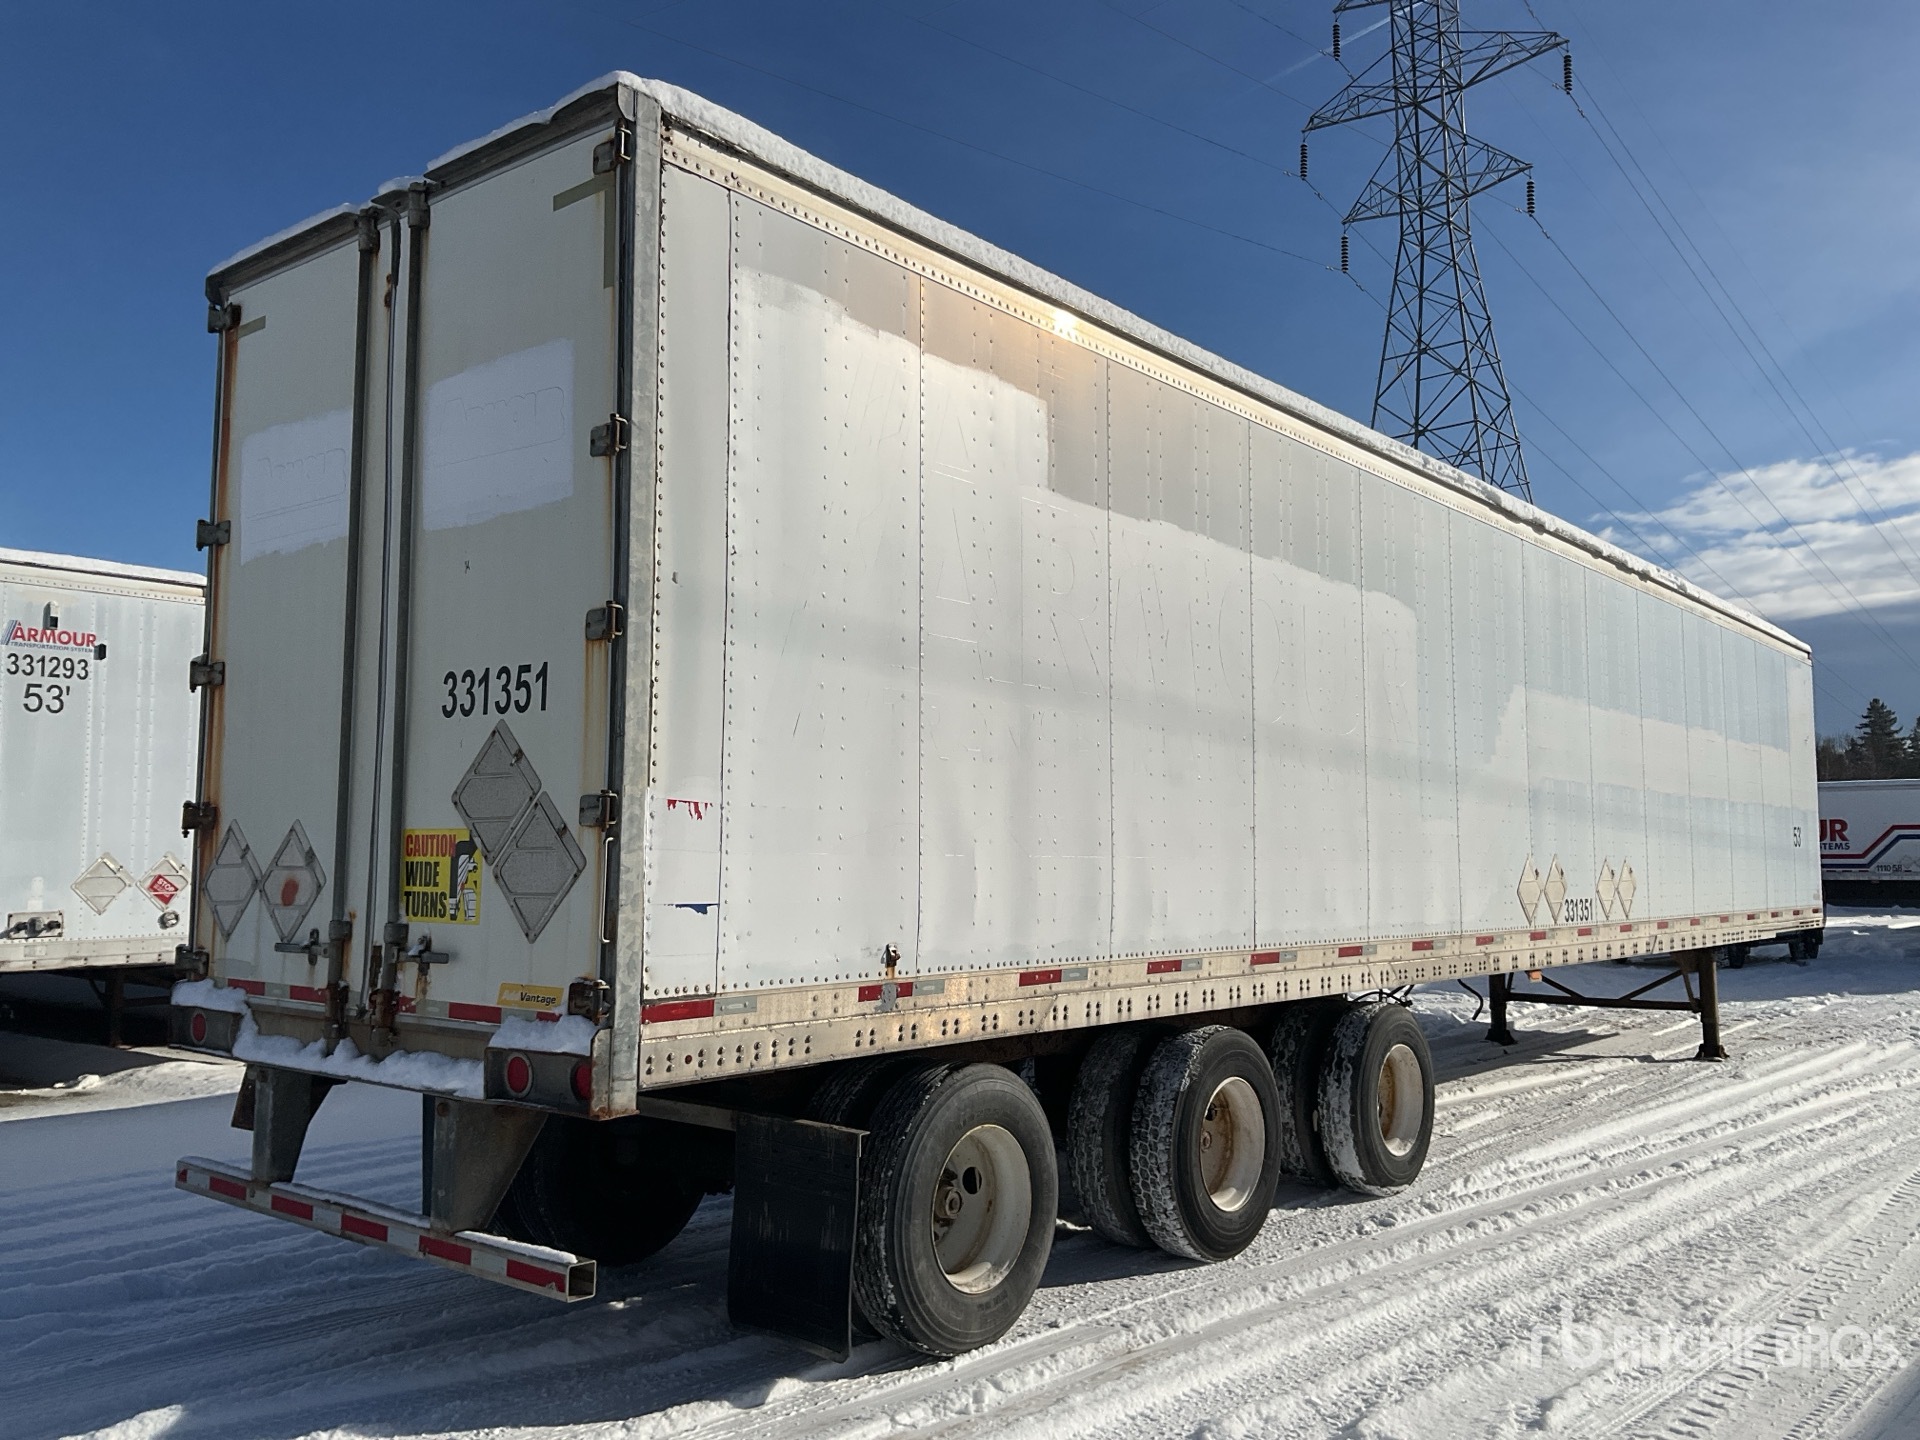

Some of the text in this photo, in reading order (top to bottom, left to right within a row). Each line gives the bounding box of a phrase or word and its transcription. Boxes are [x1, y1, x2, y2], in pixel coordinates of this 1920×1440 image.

[10, 641, 70, 652] TRANSPORTATION
[11, 623, 97, 648] ARMOUR
[6, 652, 89, 680] 331293
[23, 683, 71, 714] 53'
[441, 661, 549, 719] 331351
[405, 833, 457, 858] CAUTION
[156, 877, 176, 892] STOP
[405, 860, 440, 888] WIDE
[403, 890, 448, 919] TURNS
[1564, 897, 1594, 923] 331351
[520, 991, 557, 1007] Vantage
